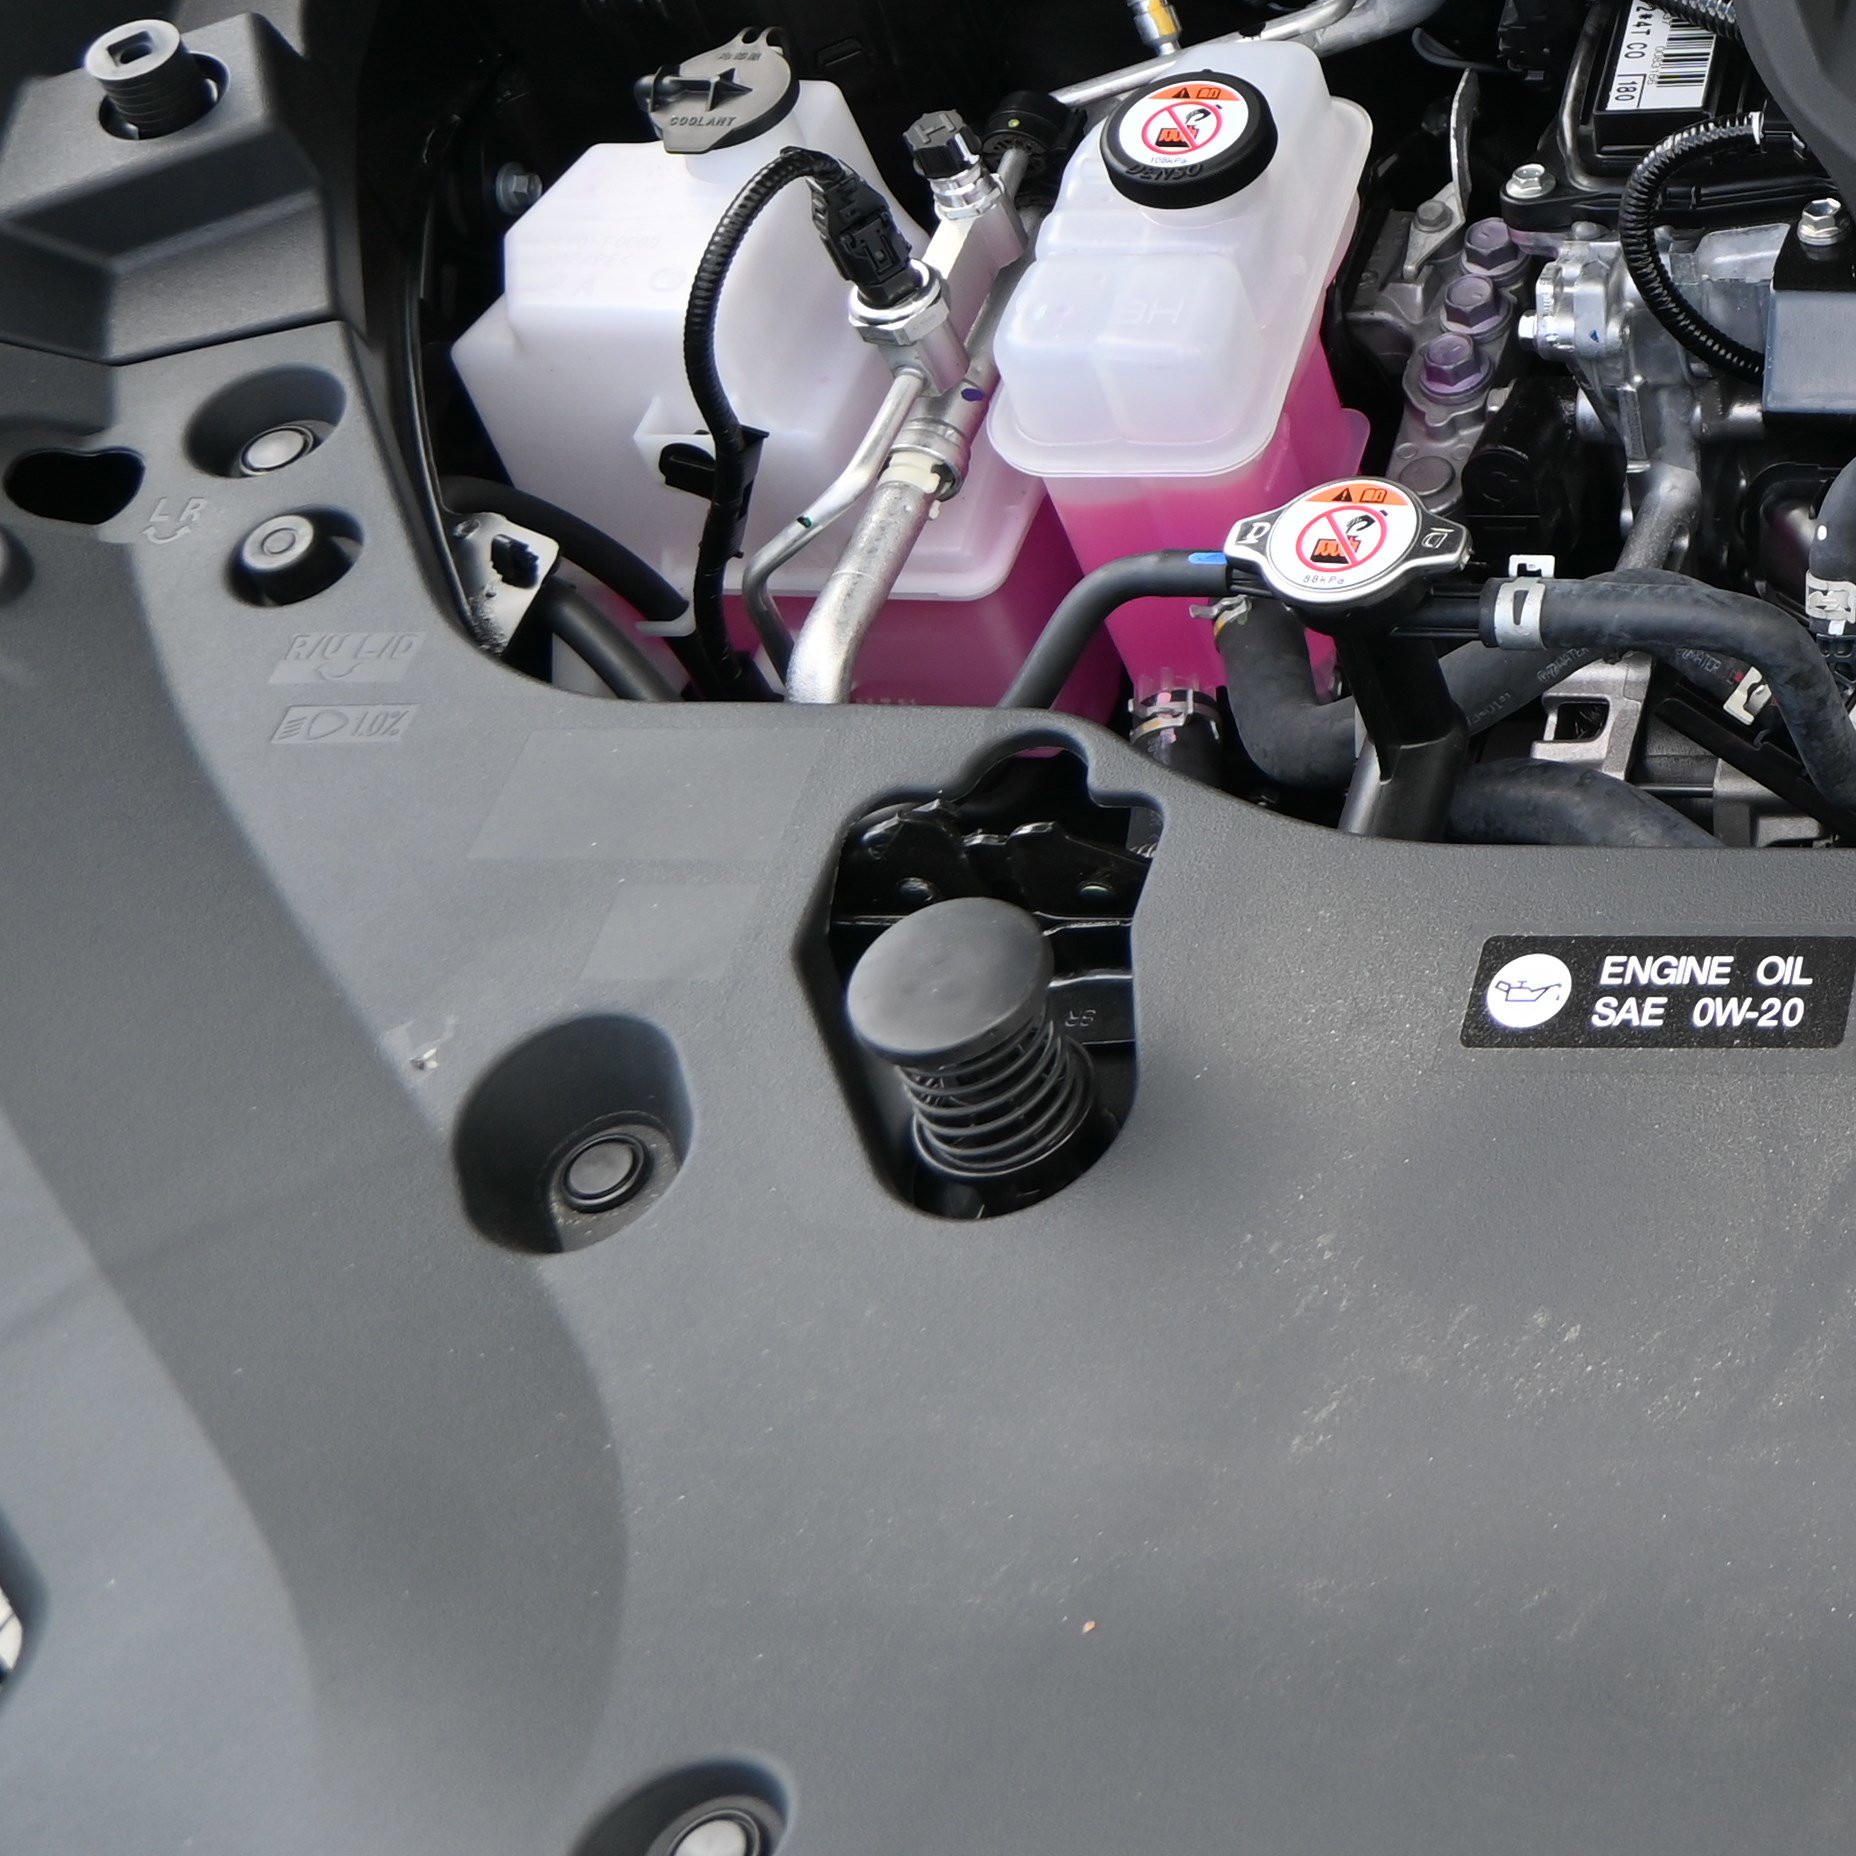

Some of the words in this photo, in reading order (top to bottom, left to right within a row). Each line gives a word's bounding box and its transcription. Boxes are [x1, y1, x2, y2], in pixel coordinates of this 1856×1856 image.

[1615, 81, 1638, 101] 180
[670, 116, 736, 127] COOLANT
[1126, 164, 1203, 180] DENSO
[150, 497, 170, 522] L
[179, 497, 208, 522] R
[350, 710, 409, 737] 1.0%
[1600, 955, 1733, 986] ENGINE
[1756, 955, 1813, 986] OIL
[1590, 996, 1667, 1028] SAE
[1692, 996, 1804, 1029] 0W-20
